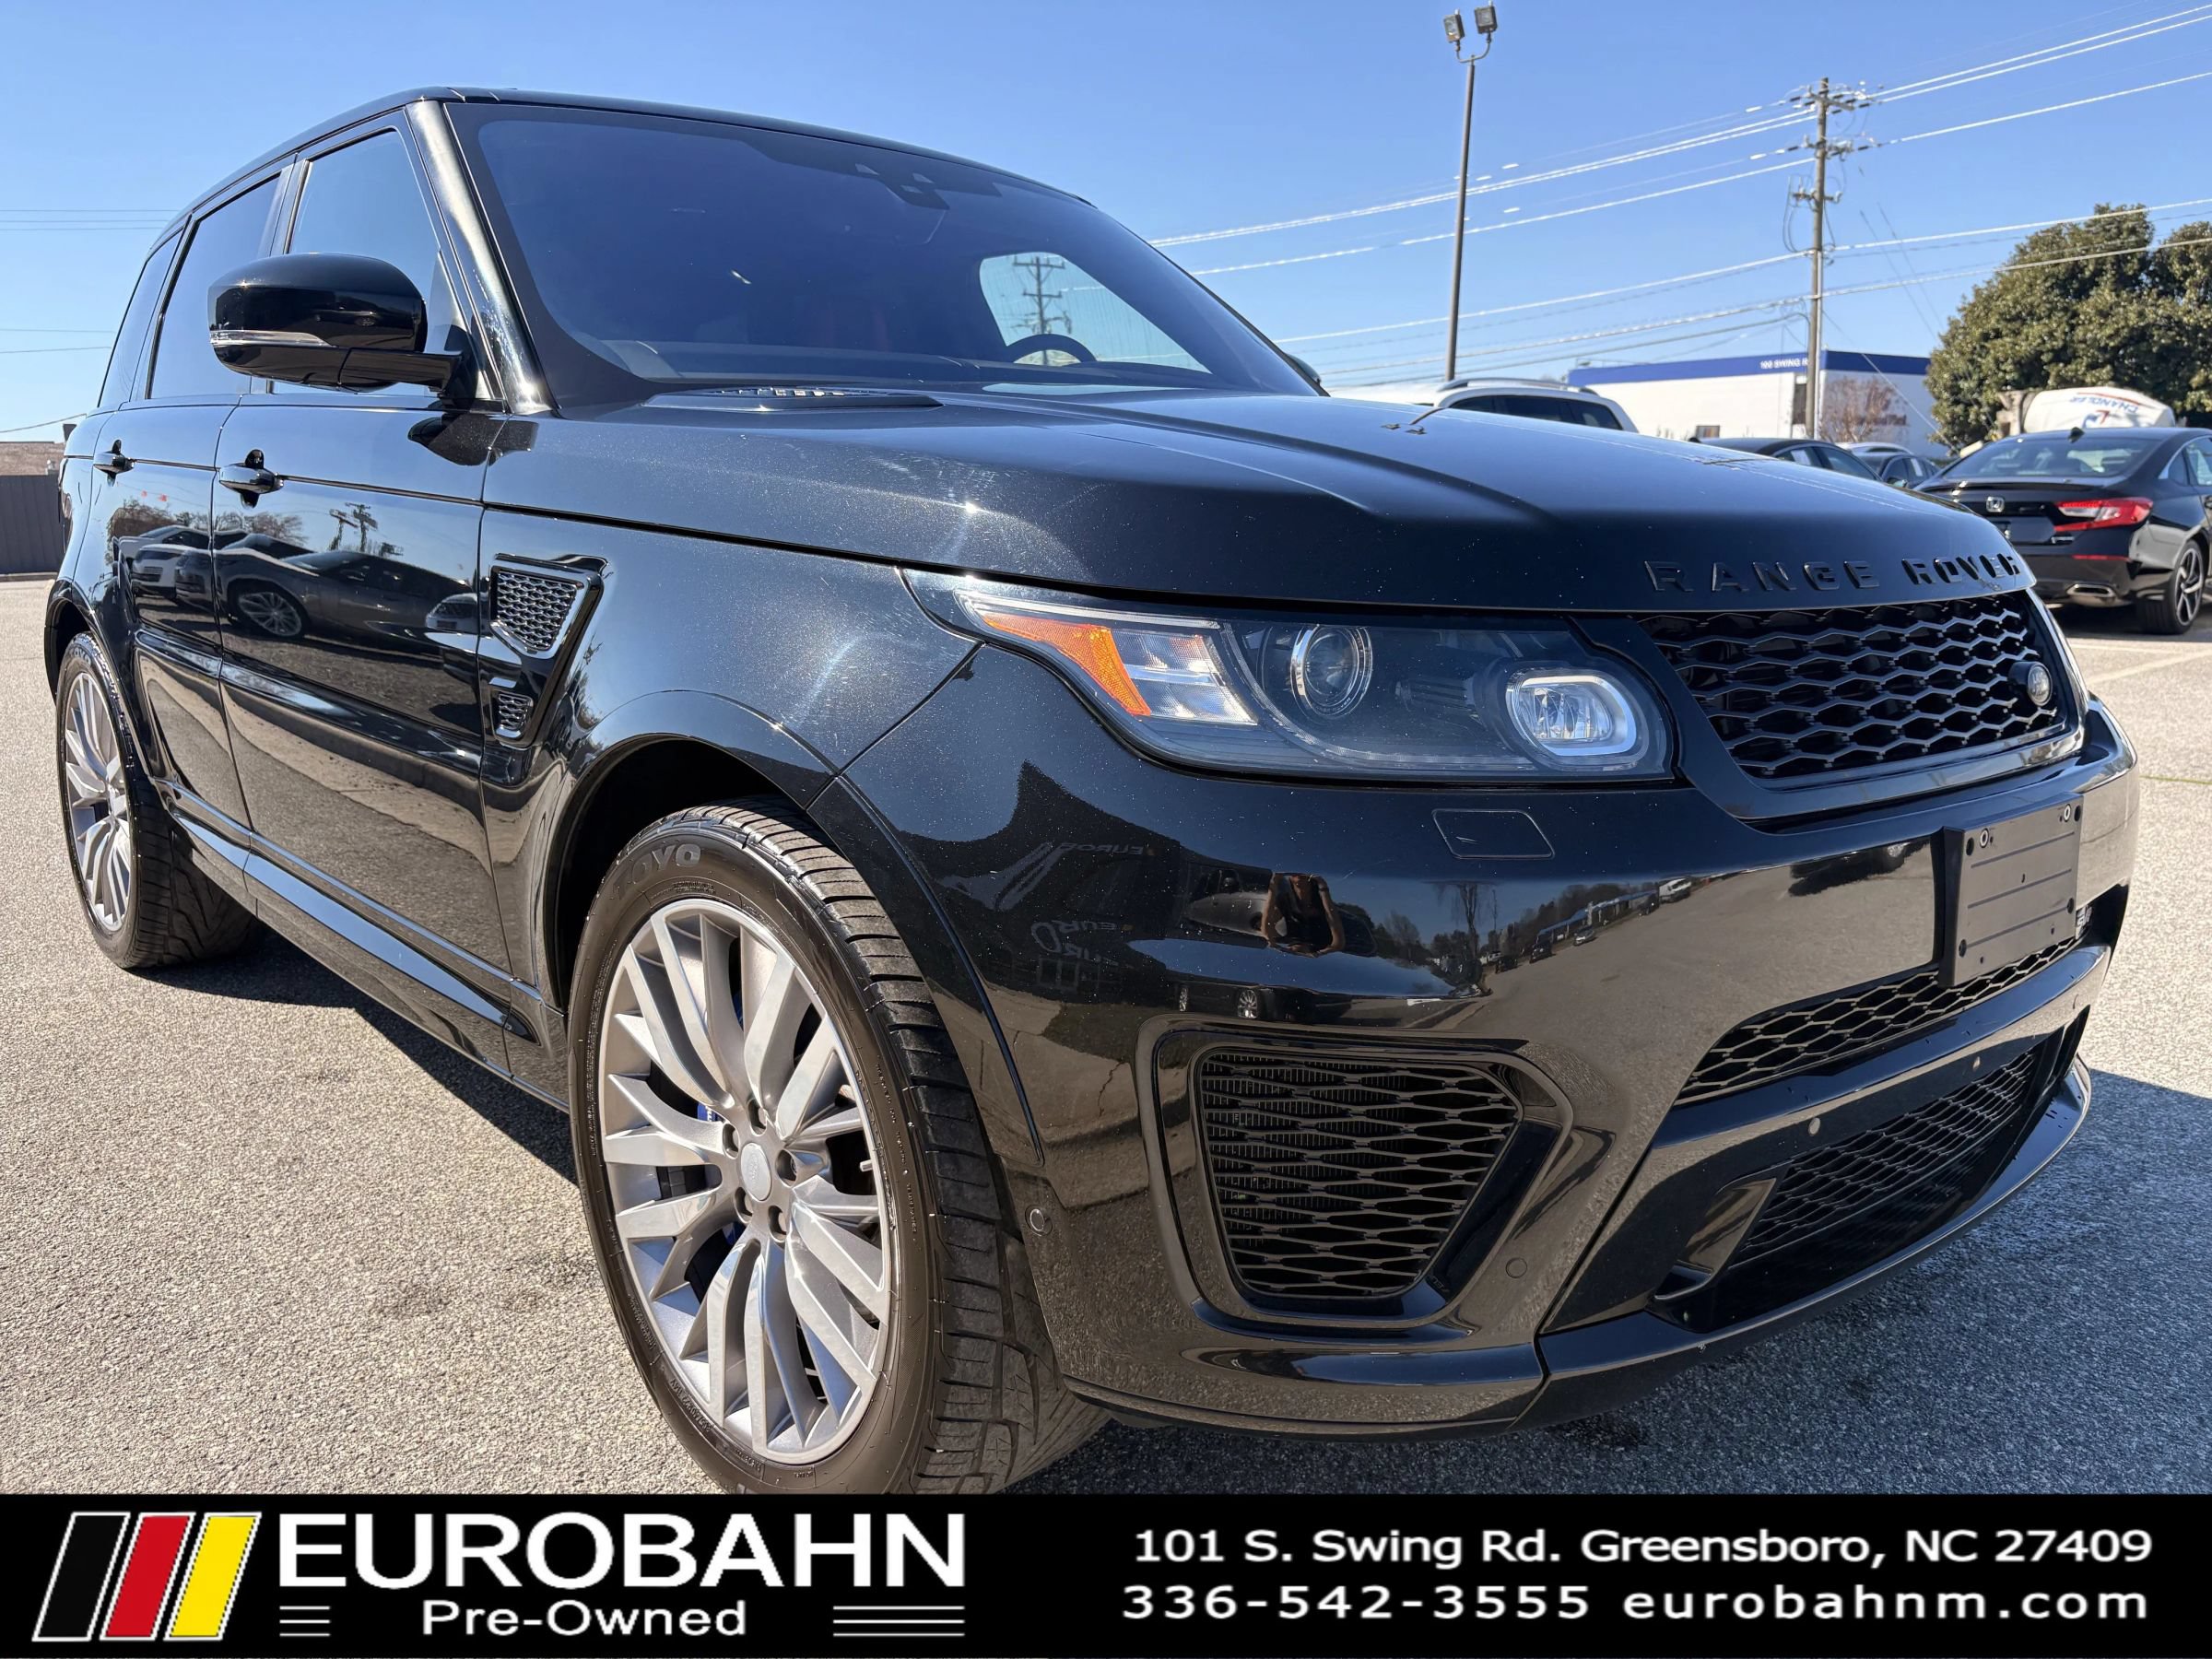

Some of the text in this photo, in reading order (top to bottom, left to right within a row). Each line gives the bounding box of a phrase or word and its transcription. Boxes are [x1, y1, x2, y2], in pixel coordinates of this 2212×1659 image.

[1774, 358, 1801, 369] SWING
[1643, 552, 2020, 593] RANGE ROVER
